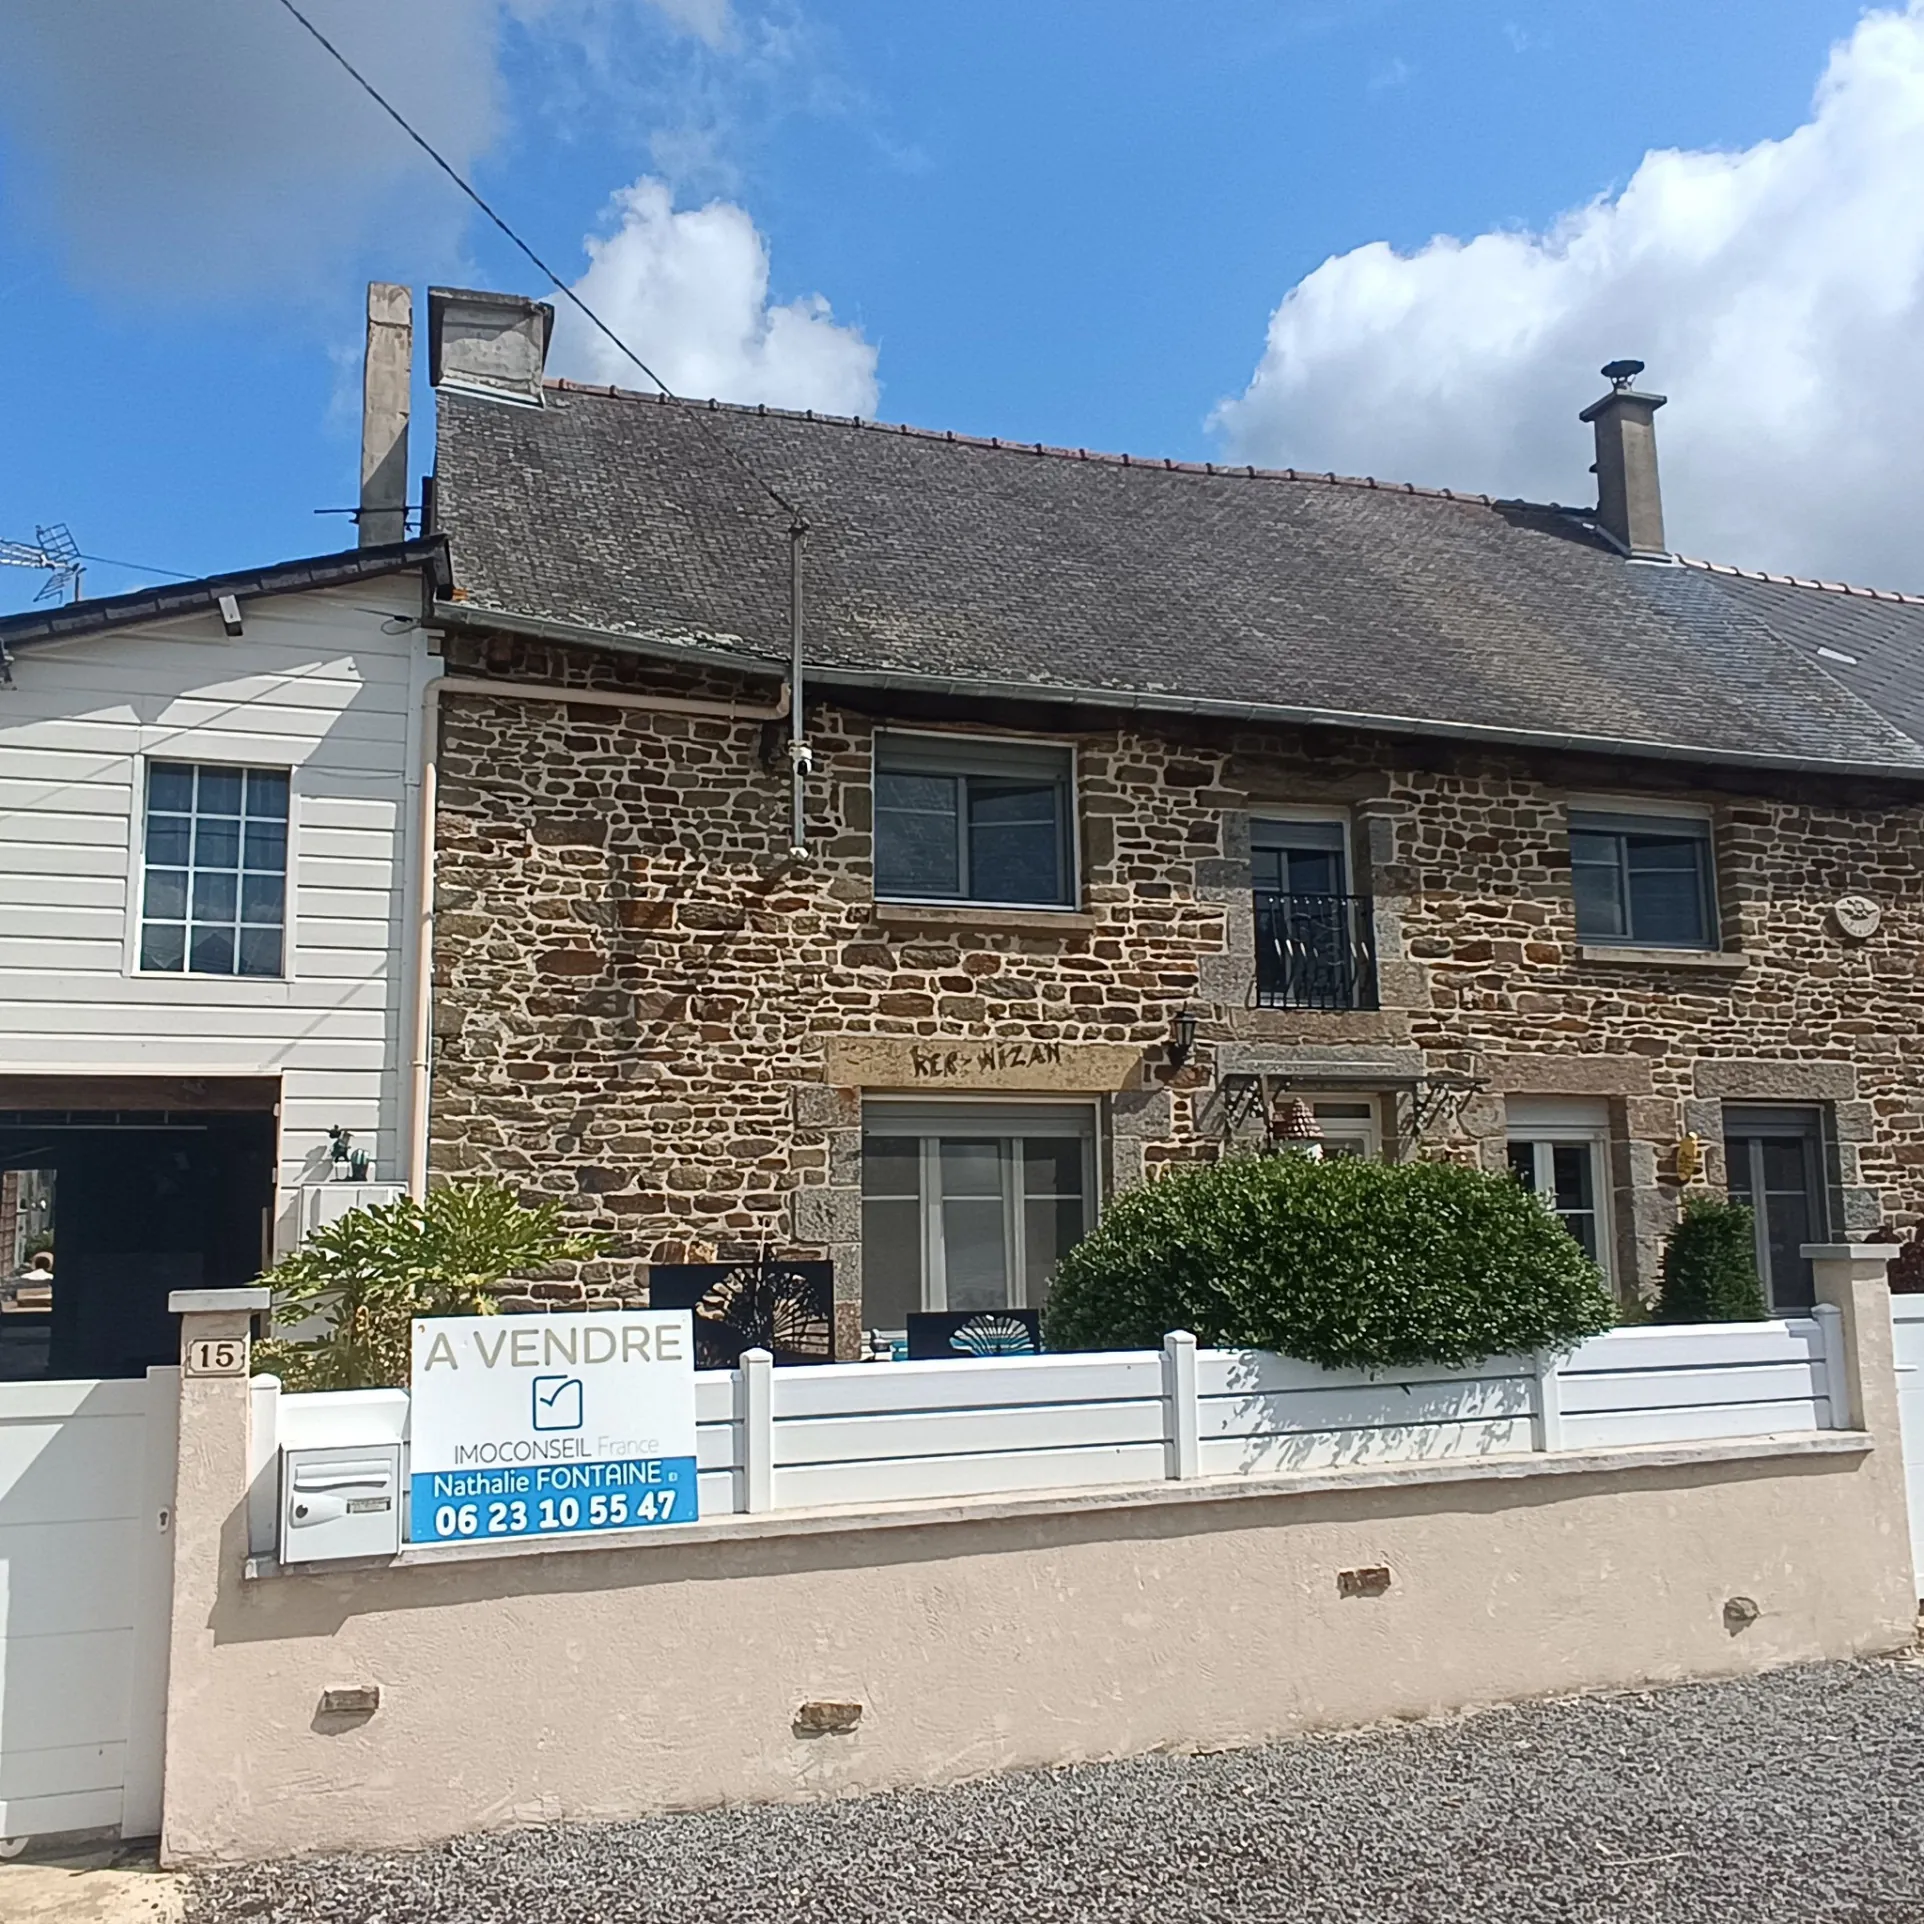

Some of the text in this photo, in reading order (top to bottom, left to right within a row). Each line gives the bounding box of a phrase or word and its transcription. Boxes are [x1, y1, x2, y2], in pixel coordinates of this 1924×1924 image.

[200, 1344, 234, 1368] 15
[424, 1325, 682, 1371] A VENDRE
[455, 1436, 659, 1464] IMOCONSEIL France
[434, 1461, 662, 1498] Nathalie FONTAINE
[435, 1490, 676, 1536] 06 23 10 55 47
